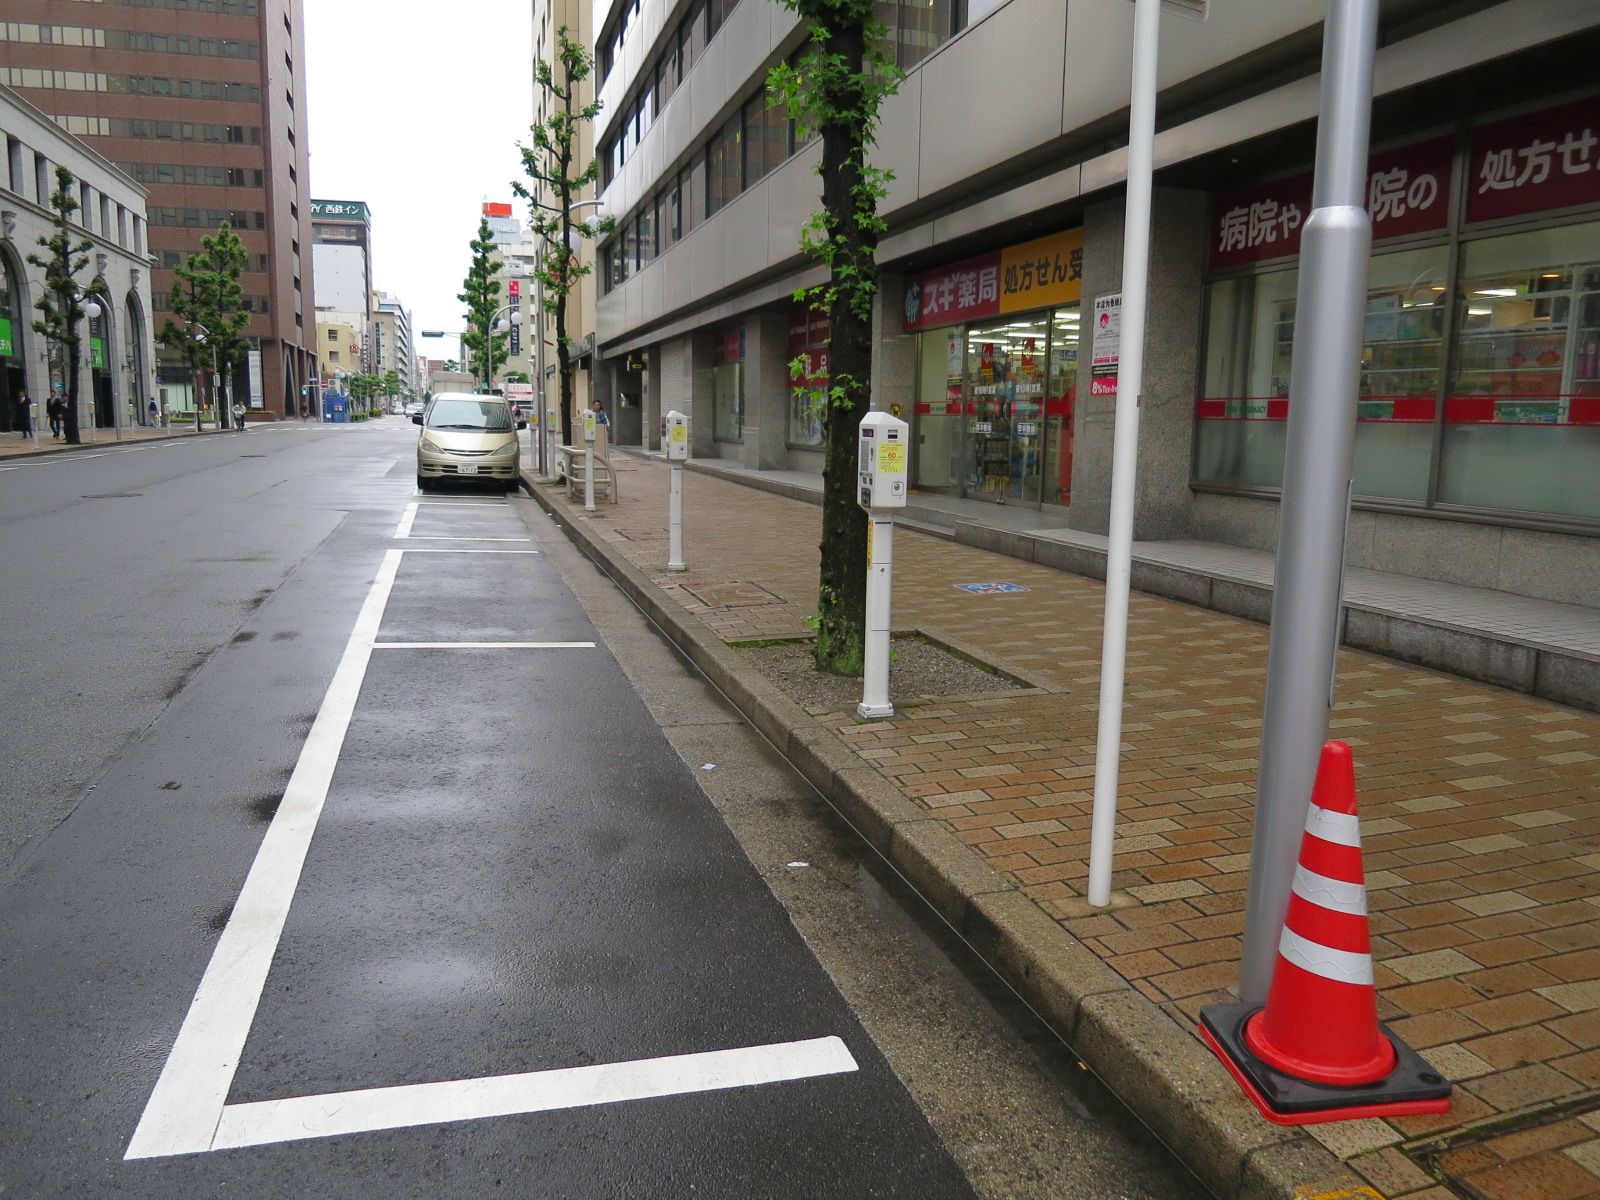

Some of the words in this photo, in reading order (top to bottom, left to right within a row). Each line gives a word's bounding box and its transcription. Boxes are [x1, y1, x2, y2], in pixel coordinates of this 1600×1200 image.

[326, 204, 359, 215] 西鉄イン
[1219, 198, 1302, 252] 病院や
[1478, 128, 1600, 194] 処方せ
[922, 266, 998, 316] スギ薬局
